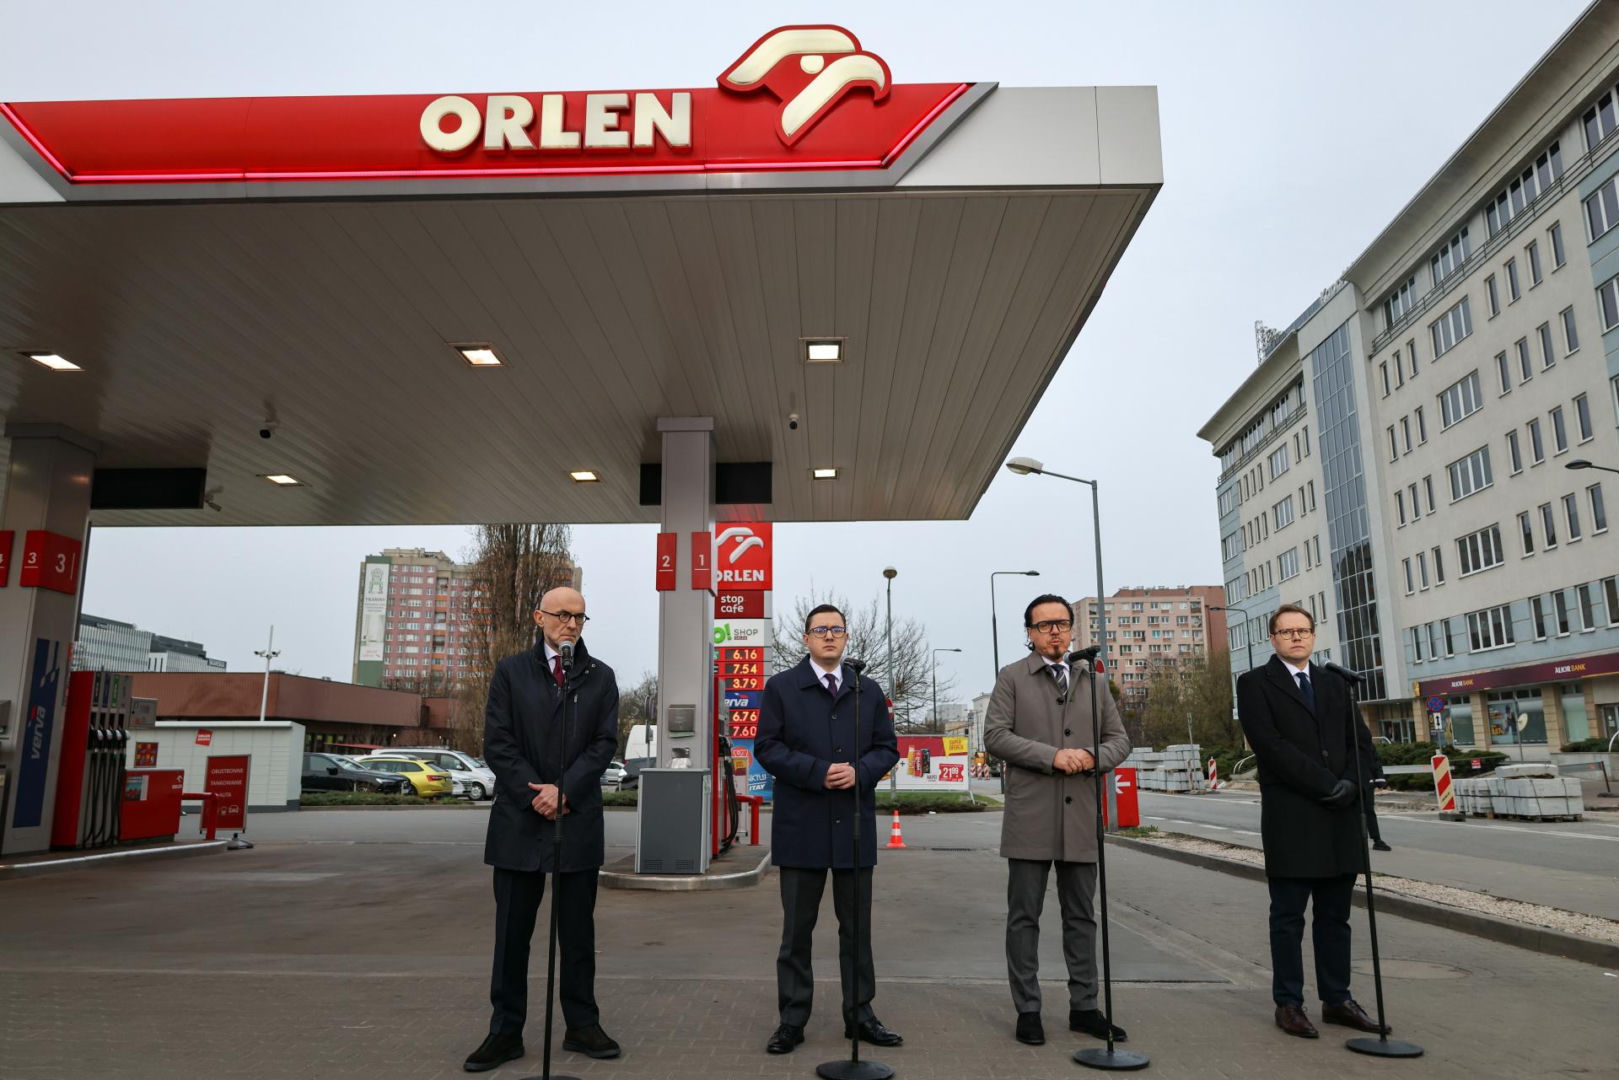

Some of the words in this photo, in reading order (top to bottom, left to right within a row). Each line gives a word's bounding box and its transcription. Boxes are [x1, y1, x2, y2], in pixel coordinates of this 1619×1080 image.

[420, 92, 692, 152] ORLEN
[27, 552, 37, 564] 3
[55, 553, 66, 573] 3
[662, 555, 670, 567] 2
[699, 554, 704, 566] 1
[721, 595, 744, 605] stop
[721, 604, 744, 613] cafe
[733, 649, 757, 660] 6.16
[733, 664, 757, 674] 7.54
[733, 678, 757, 688] 3.79
[724, 699, 749, 707] erva
[733, 711, 757, 722] 6.76
[31, 705, 46, 759] verva
[733, 726, 757, 737] 7.60
